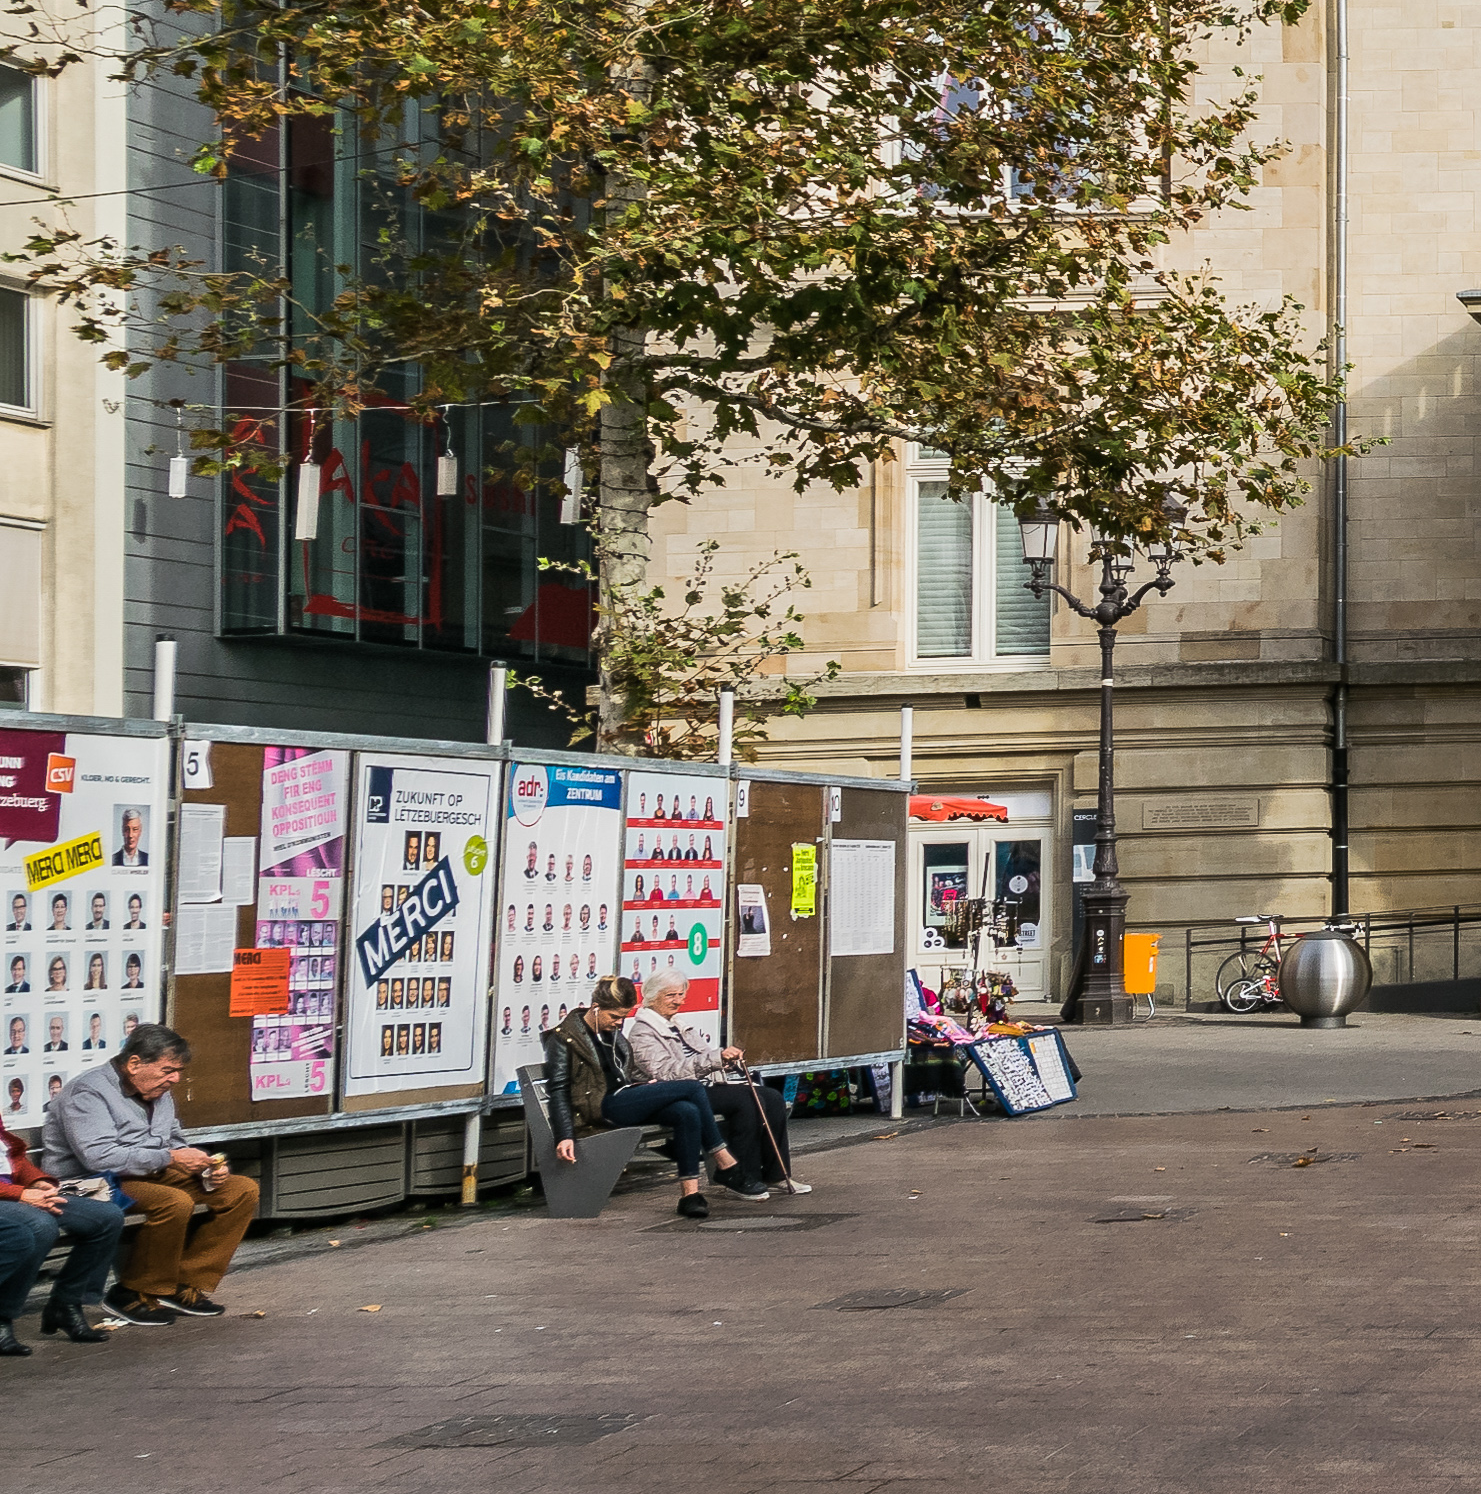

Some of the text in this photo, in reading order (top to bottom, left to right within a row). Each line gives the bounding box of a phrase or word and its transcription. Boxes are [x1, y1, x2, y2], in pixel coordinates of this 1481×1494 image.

[186, 751, 200, 776] 5
[50, 768, 74, 783] CSV
[271, 768, 298, 785] DENG
[566, 769, 604, 783] Kandidaten
[284, 779, 322, 799] FIR ENG
[396, 790, 463, 807] ZUKUNFT OP
[566, 787, 602, 801] ZENTRUM
[738, 789, 745, 807] 9
[271, 793, 336, 820] KONSEQUENT
[831, 794, 840, 812] 10
[272, 810, 337, 838] OPPOSITIOUN
[470, 856, 479, 869] 6
[310, 880, 330, 919] 5
[363, 869, 452, 975] MERCI
[693, 932, 703, 956] 8
[310, 1061, 325, 1093] 5
